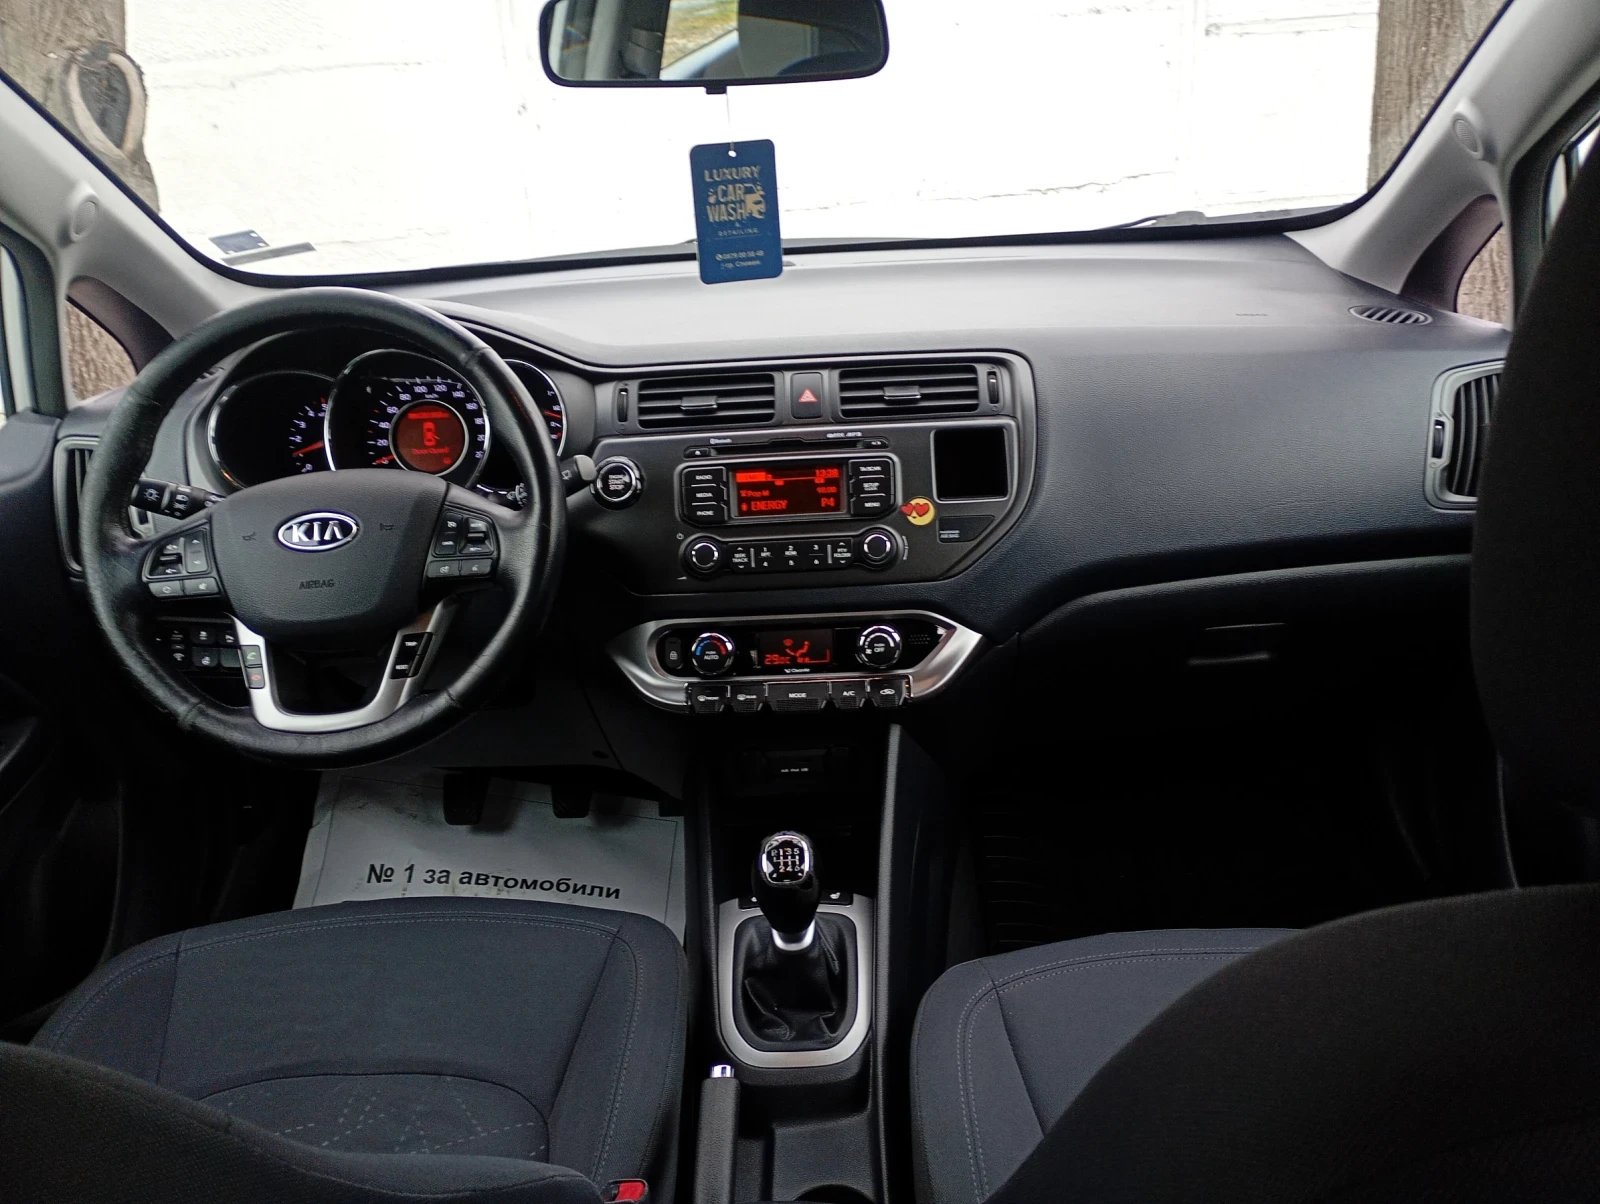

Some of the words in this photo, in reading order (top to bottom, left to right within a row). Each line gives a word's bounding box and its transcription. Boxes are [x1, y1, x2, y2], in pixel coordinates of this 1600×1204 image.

[704, 165, 761, 182] LUXURY
[717, 183, 746, 202] CAR
[706, 202, 749, 222] WASH
[413, 385, 428, 393] 100
[433, 384, 448, 392] 120
[399, 393, 412, 401] 80
[452, 390, 465, 398] 140
[386, 406, 399, 414] 60
[379, 421, 391, 429] 40
[376, 439, 389, 447] 20
[751, 500, 788, 511] ENERGY
[821, 497, 836, 507] P4
[291, 520, 344, 542] KIA
[298, 578, 336, 590] AIRBAG
[784, 847, 793, 855] 3
[793, 847, 800, 855] 5
[779, 865, 786, 873] 2
[403, 863, 415, 884] 1
[423, 869, 451, 885] за
[458, 871, 621, 900] автомобили
